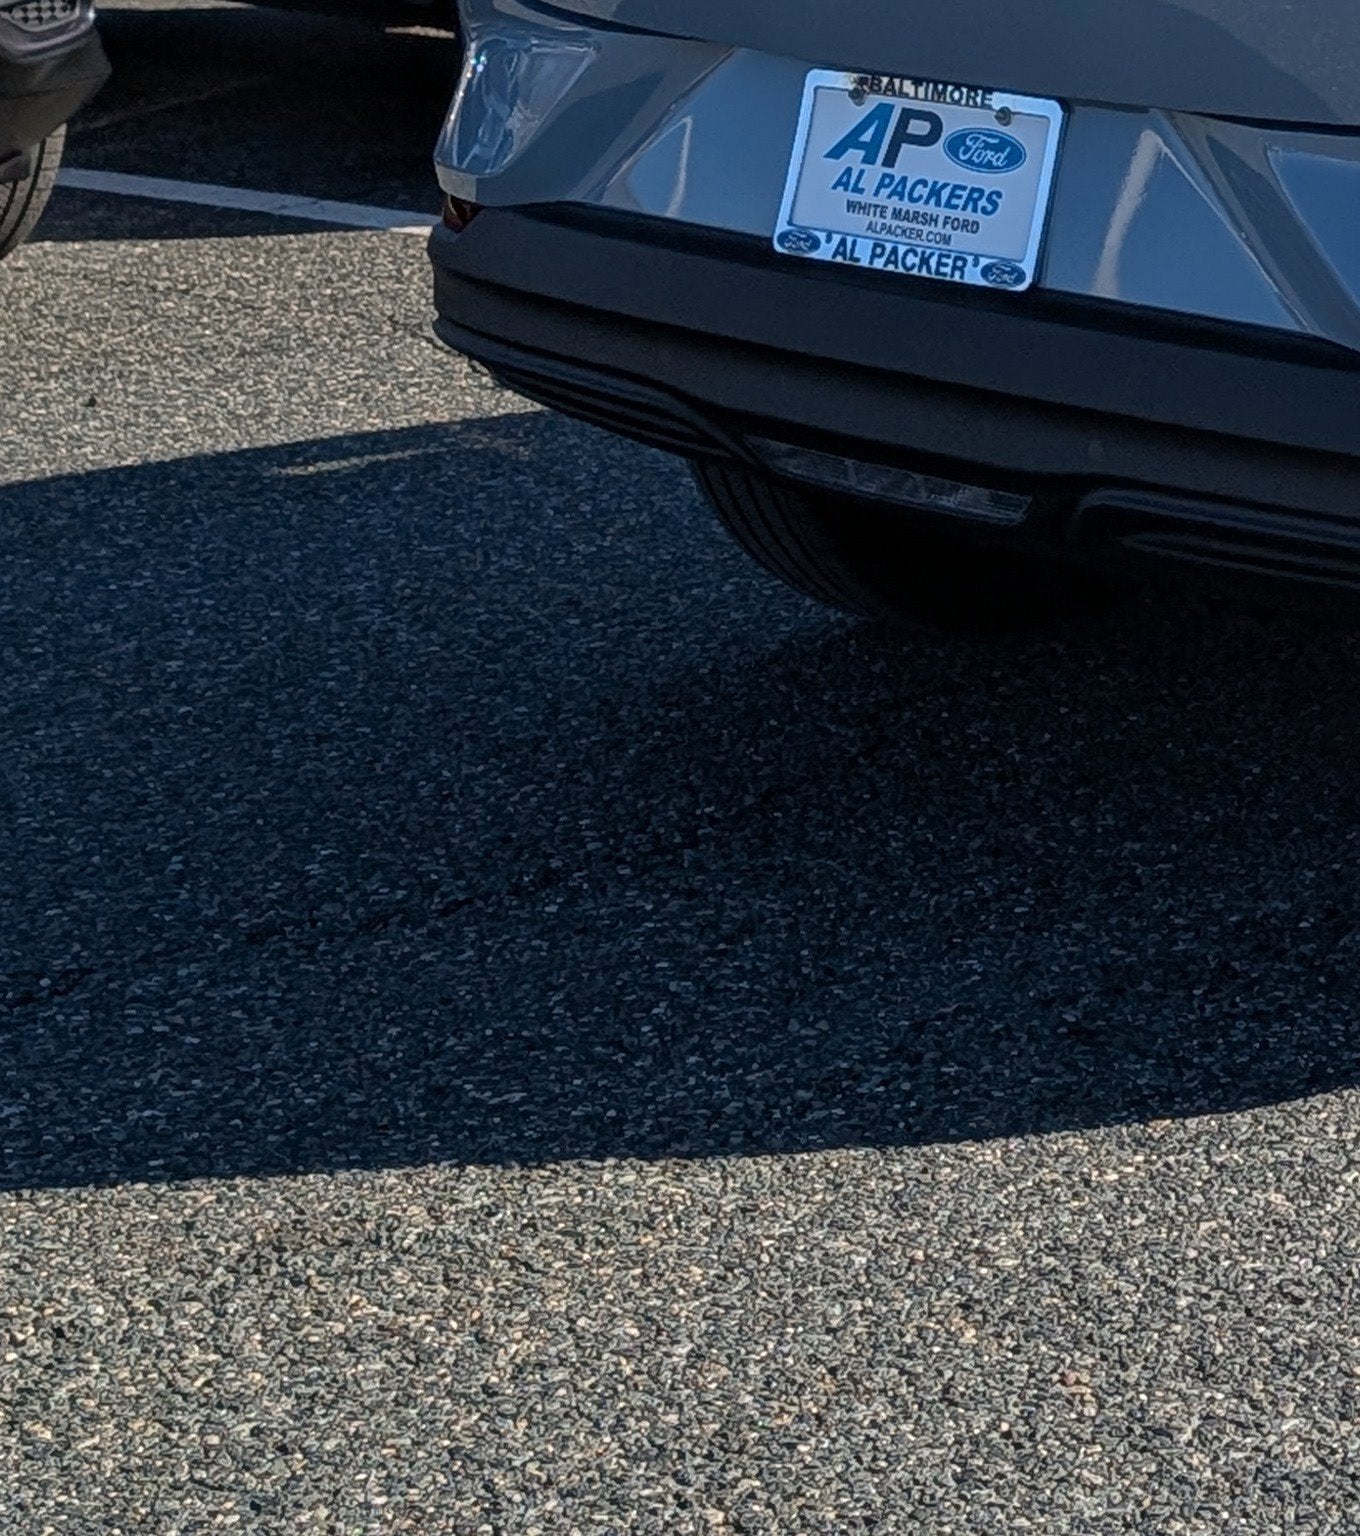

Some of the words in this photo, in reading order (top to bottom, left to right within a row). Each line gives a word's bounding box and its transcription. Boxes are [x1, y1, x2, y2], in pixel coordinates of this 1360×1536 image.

[869, 74, 994, 109] BALTIMORE
[823, 101, 944, 169] AP
[957, 133, 1009, 168] Ford
[831, 166, 867, 195] AL
[874, 168, 1004, 217] PACKERS
[846, 199, 888, 218] WHITE
[890, 206, 939, 229] MARSH
[942, 215, 980, 235] FORD
[866, 220, 953, 245] ALPACKER.COM
